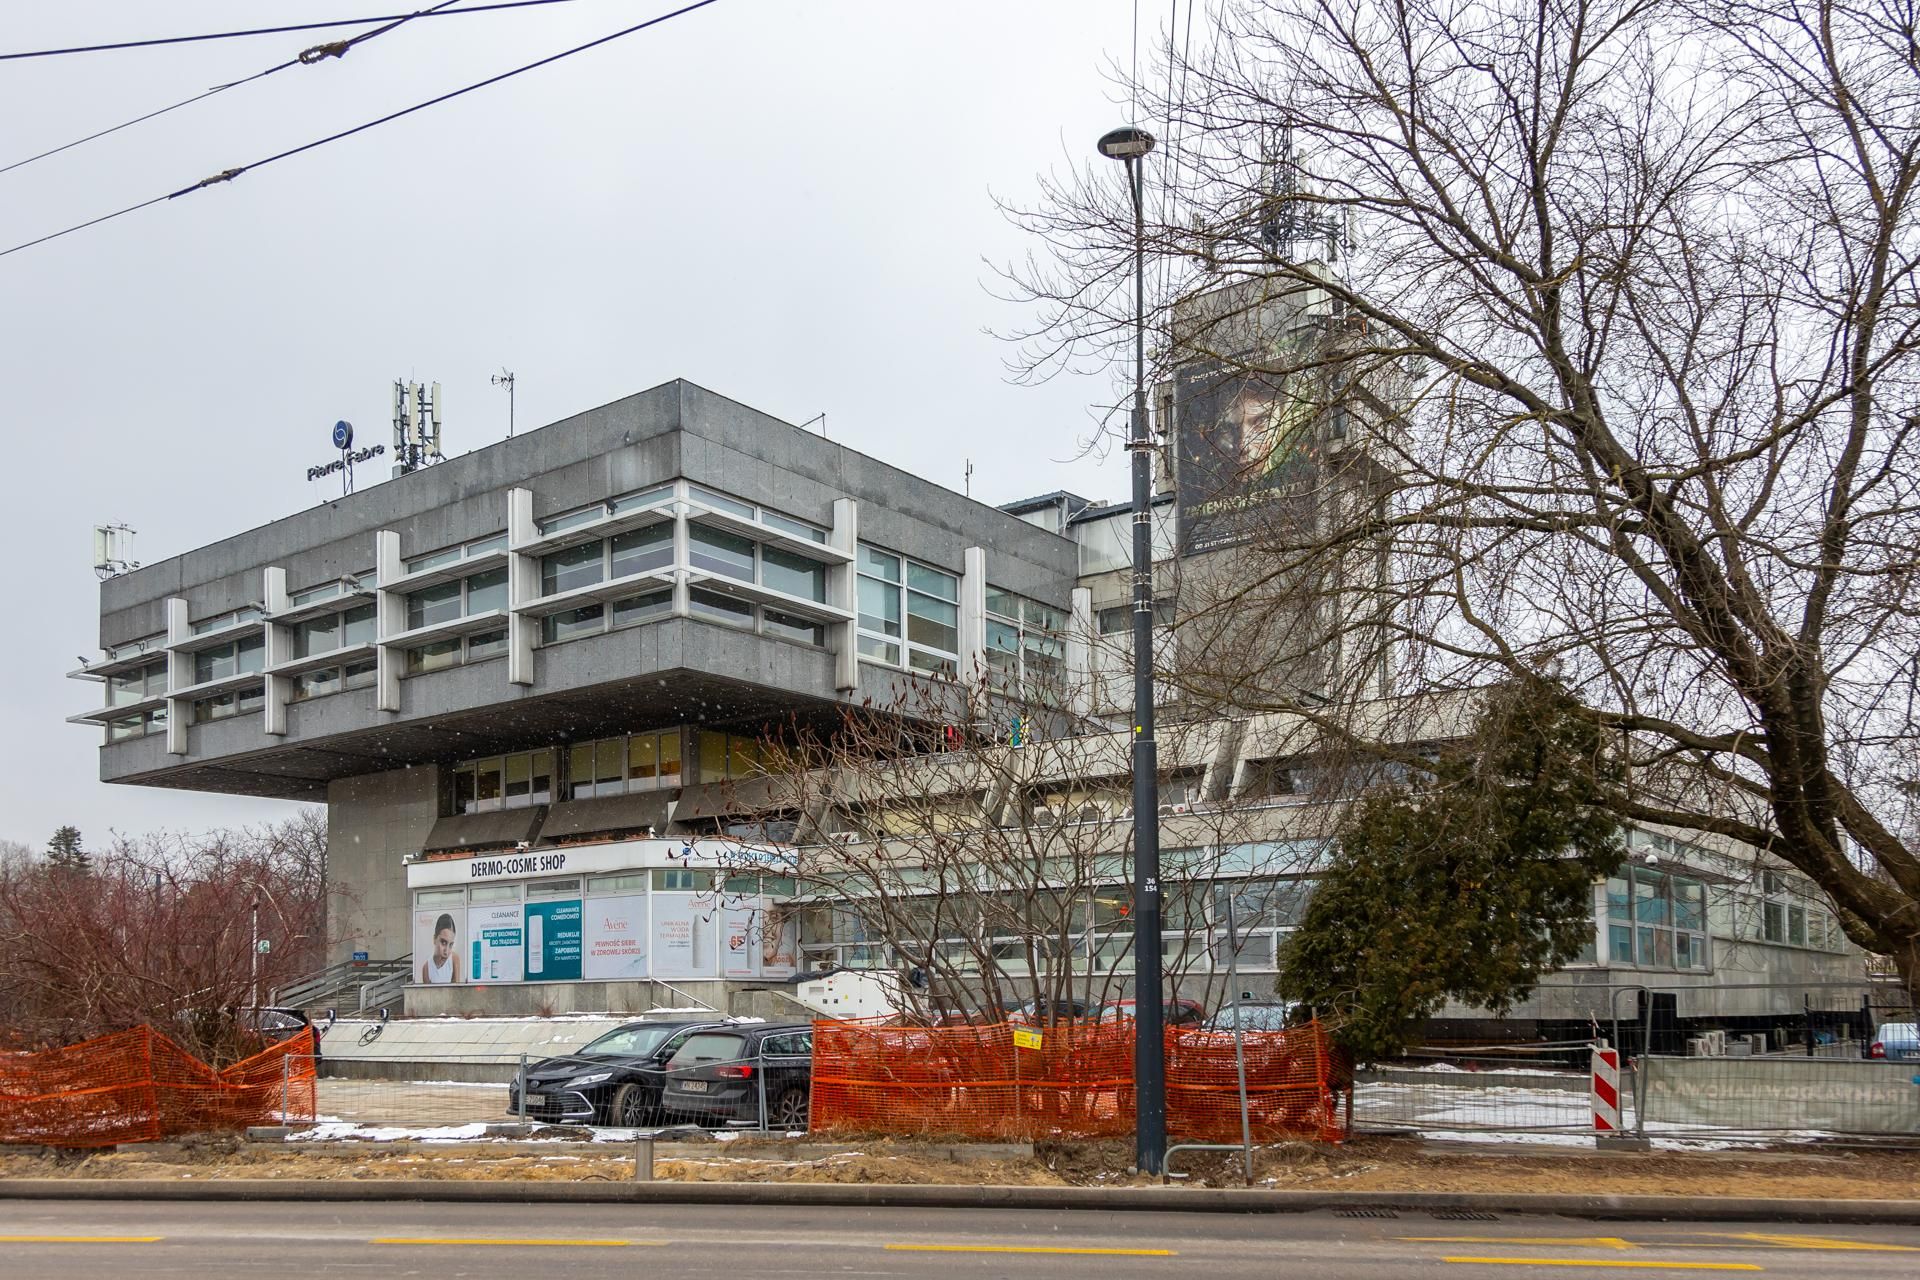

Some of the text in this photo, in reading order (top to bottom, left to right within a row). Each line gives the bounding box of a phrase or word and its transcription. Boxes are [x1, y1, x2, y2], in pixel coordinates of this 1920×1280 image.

[307, 444, 385, 482] Pierre Fabre
[471, 854, 566, 878] DERMO-COSME SHOP
[491, 910, 520, 919] CLEANANCE
[556, 906, 580, 914] CLEANANCE
[595, 938, 636, 947] PEWNOŚĆ SIEBIE
[596, 948, 621, 956] ZDROWEJ
[622, 947, 641, 955] SKÓRZE
